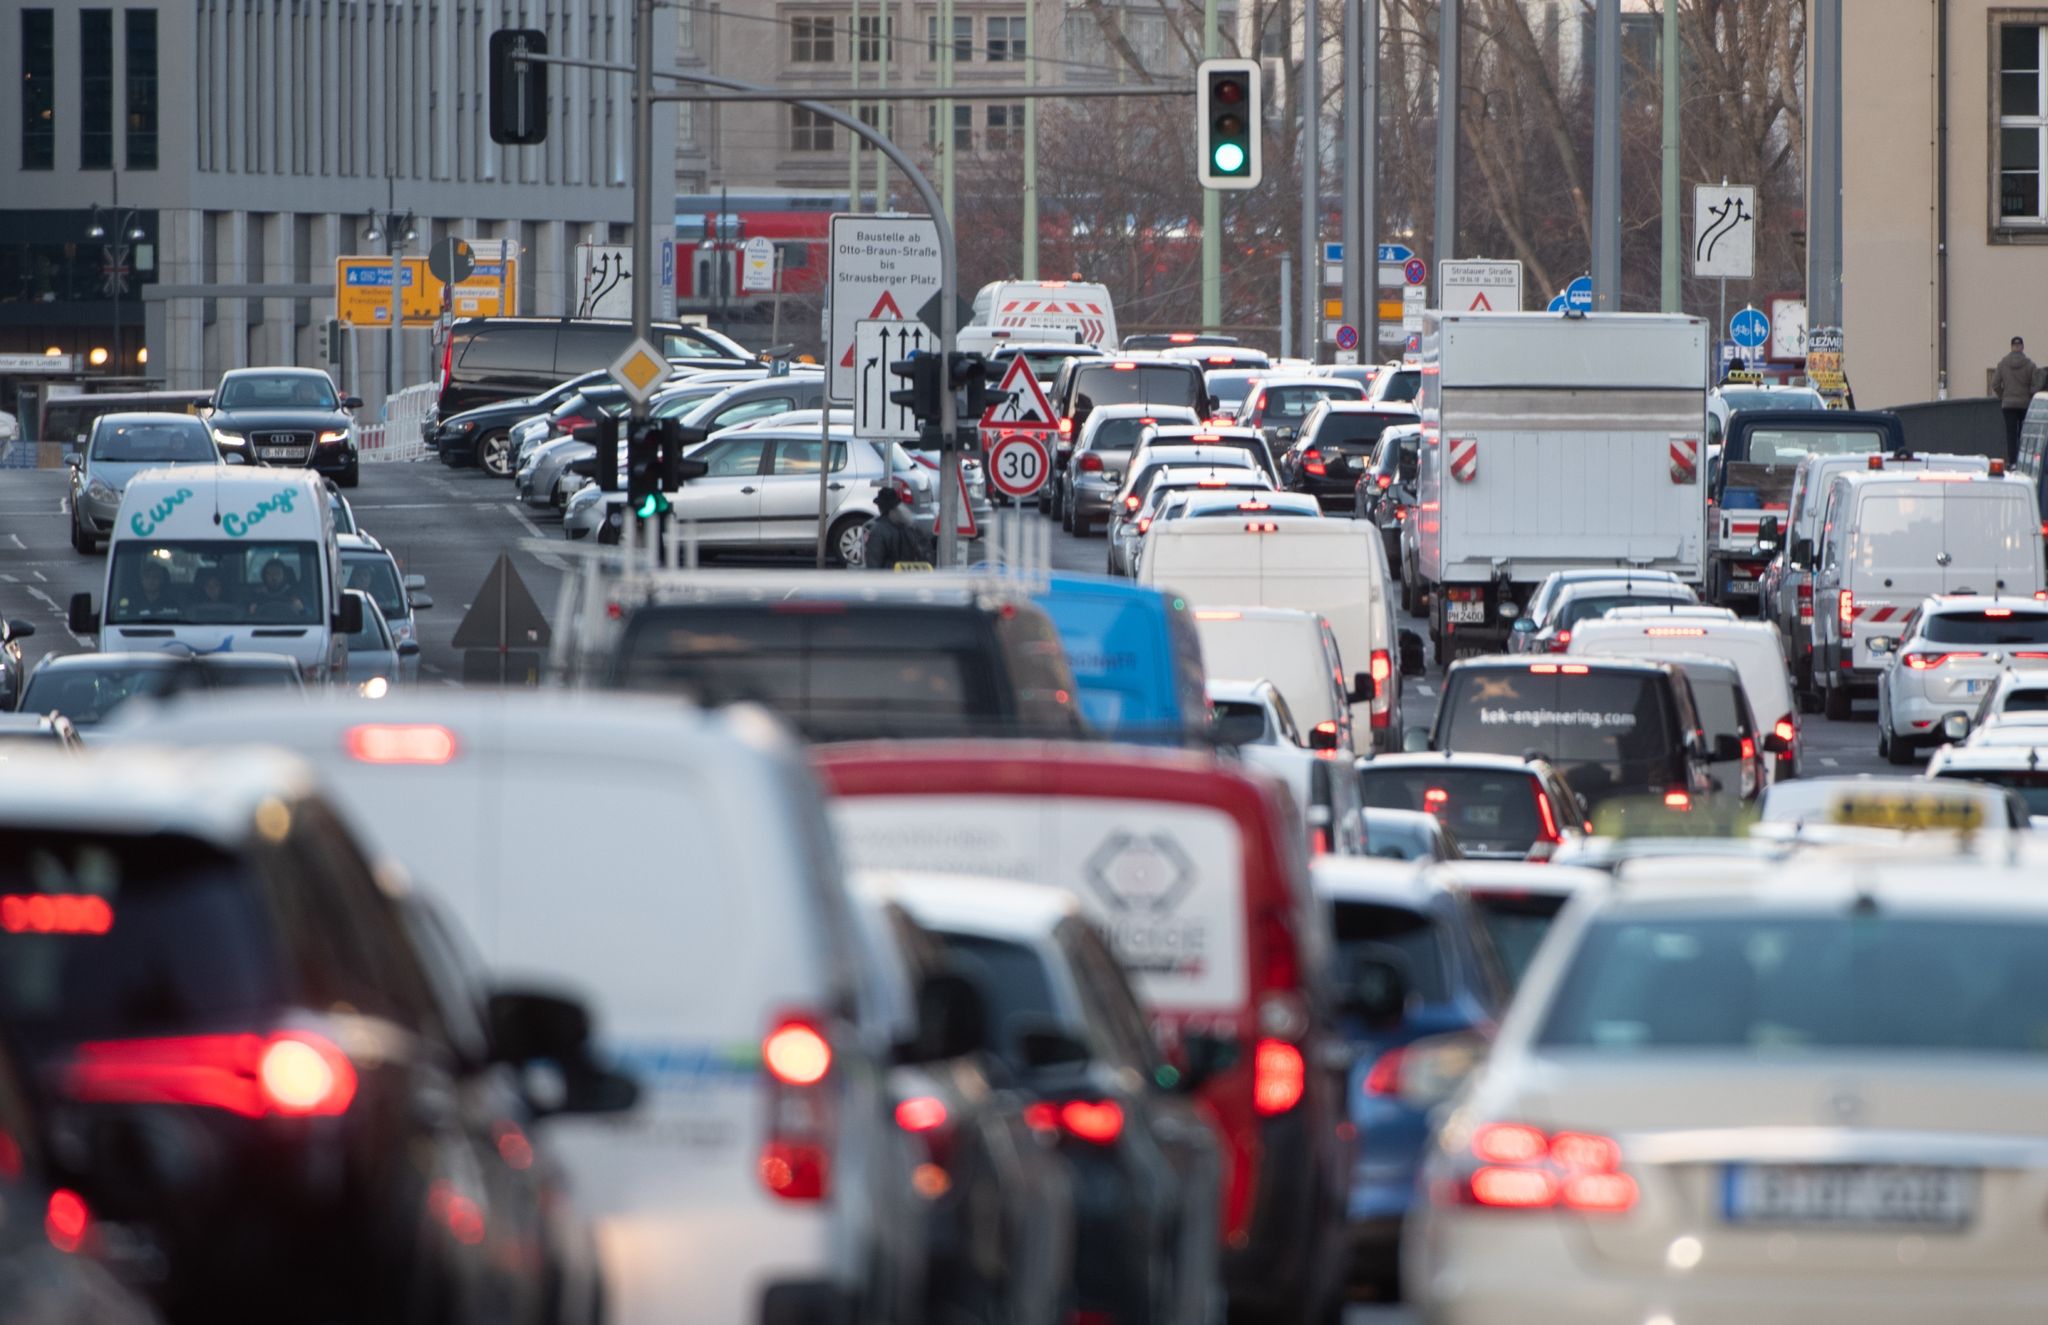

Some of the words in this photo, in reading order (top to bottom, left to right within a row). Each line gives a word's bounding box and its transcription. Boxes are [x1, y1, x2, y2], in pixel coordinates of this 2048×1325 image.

[857, 231, 905, 242] Baustelle
[908, 233, 921, 243] ab
[839, 244, 937, 257] Otto-Braun-Straße
[880, 260, 895, 270] bis
[1488, 268, 1512, 276] Straße
[839, 272, 907, 286] Strausberger
[911, 274, 936, 285] Platz
[778, 360, 787, 374] P
[1003, 451, 1036, 479] 30
[131, 488, 193, 537] Euro
[222, 488, 298, 537] Cargo
[1480, 708, 1636, 728] kek-engineering.com
